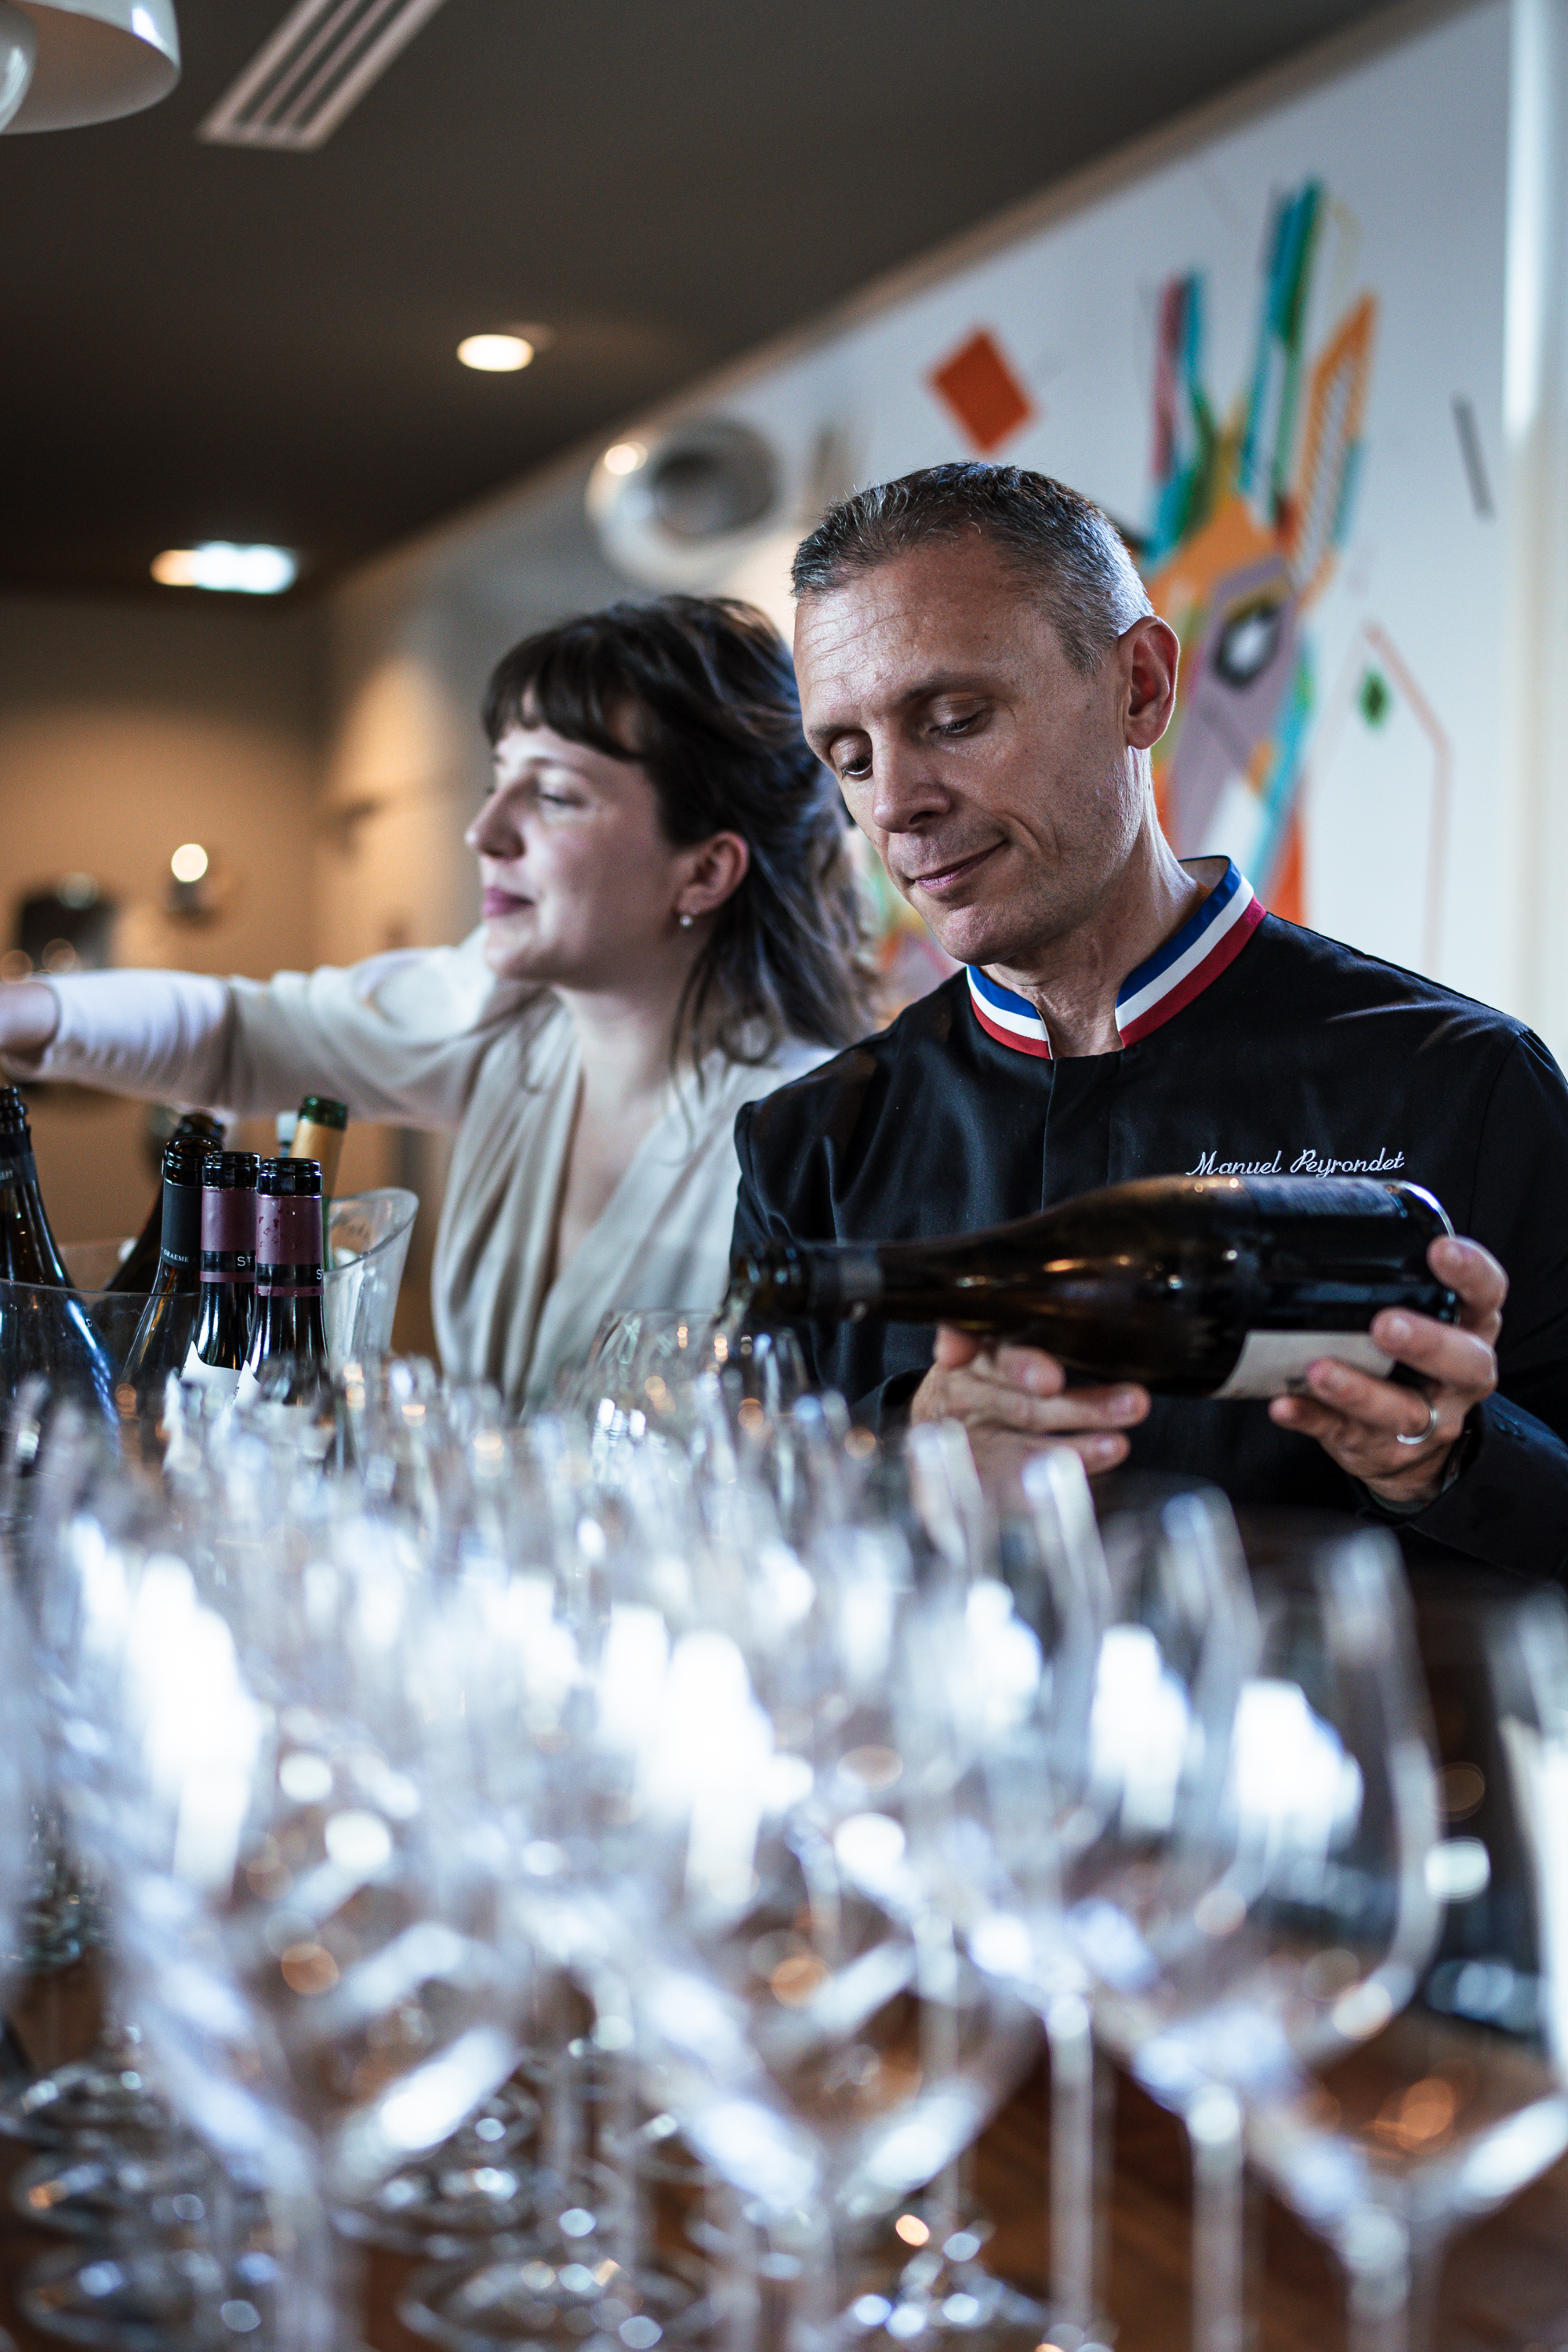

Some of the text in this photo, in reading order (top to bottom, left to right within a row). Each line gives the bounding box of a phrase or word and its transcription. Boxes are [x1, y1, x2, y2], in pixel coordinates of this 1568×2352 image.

[1185, 1147, 1406, 1179] Manuel Peyrondet
[163, 1248, 190, 1263] GRAEME
